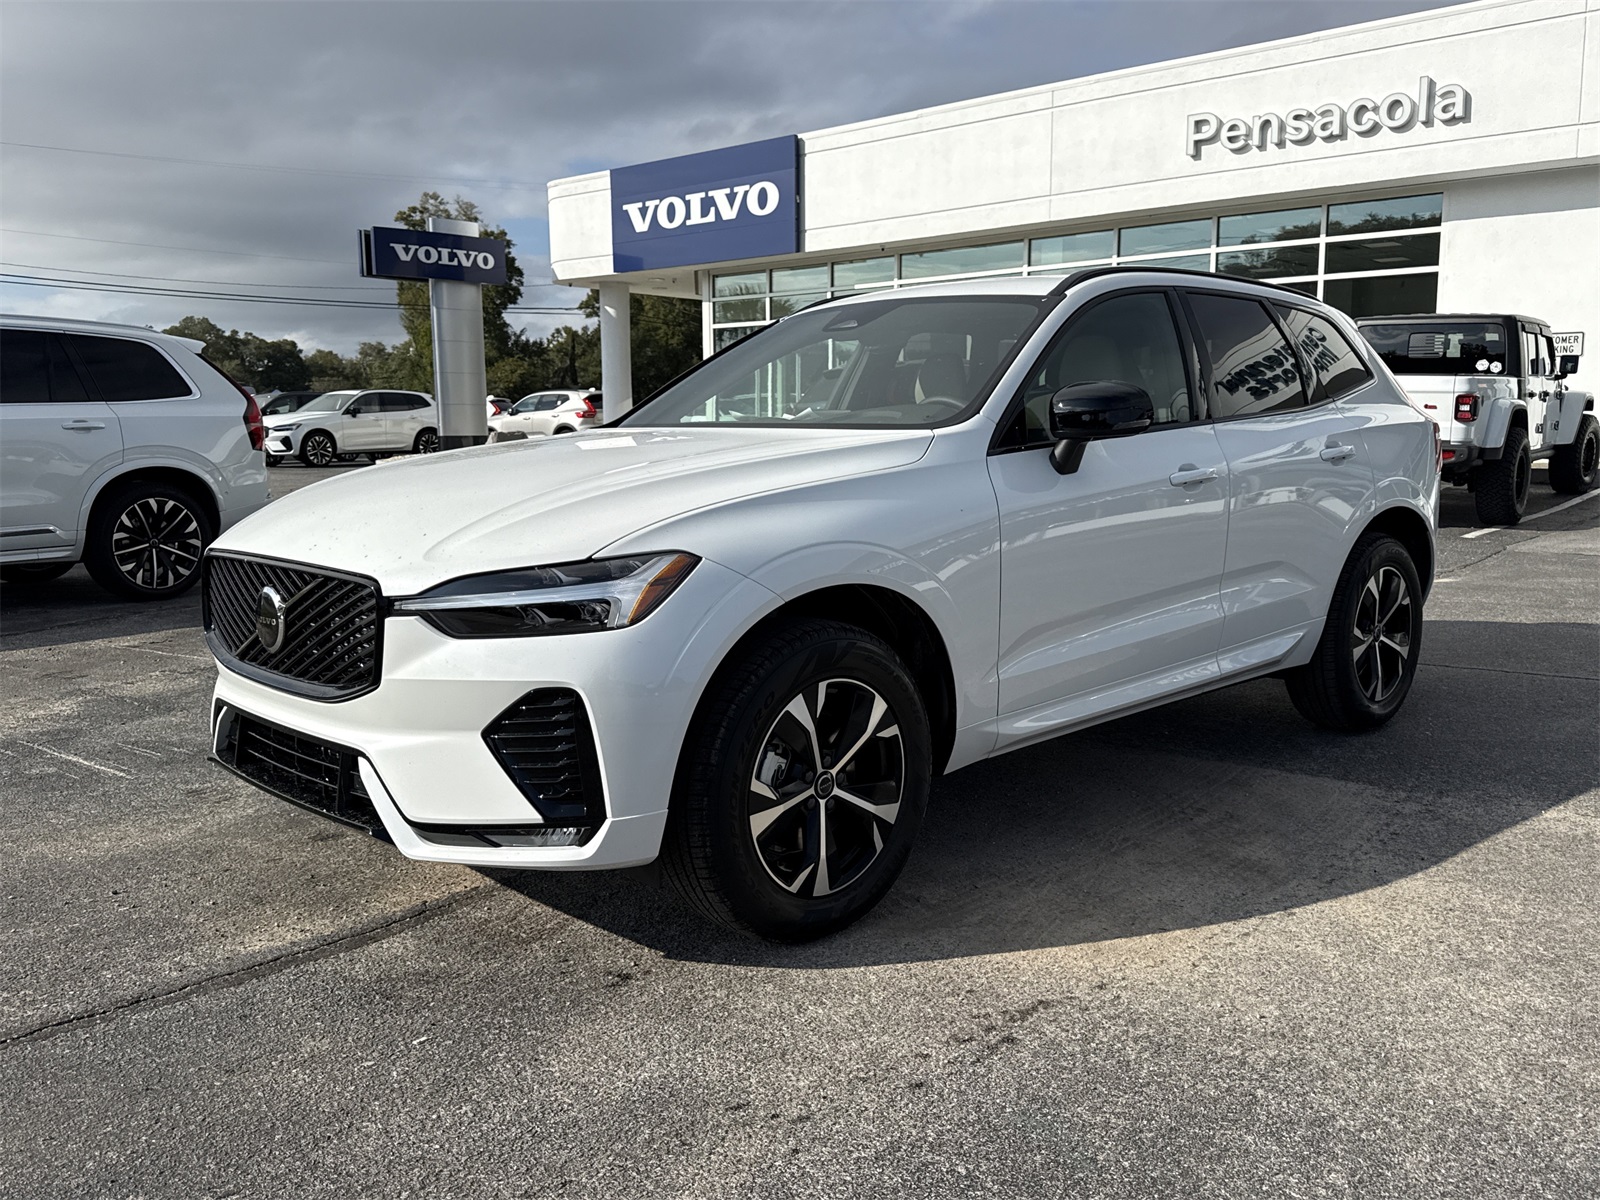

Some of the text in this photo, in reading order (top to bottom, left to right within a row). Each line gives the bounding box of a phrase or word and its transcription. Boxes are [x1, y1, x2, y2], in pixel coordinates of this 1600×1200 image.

[1186, 75, 1472, 161] Pensacola
[622, 181, 780, 233] VOLVO
[389, 243, 495, 270] VOLVO
[1553, 335, 1580, 345] OMER
